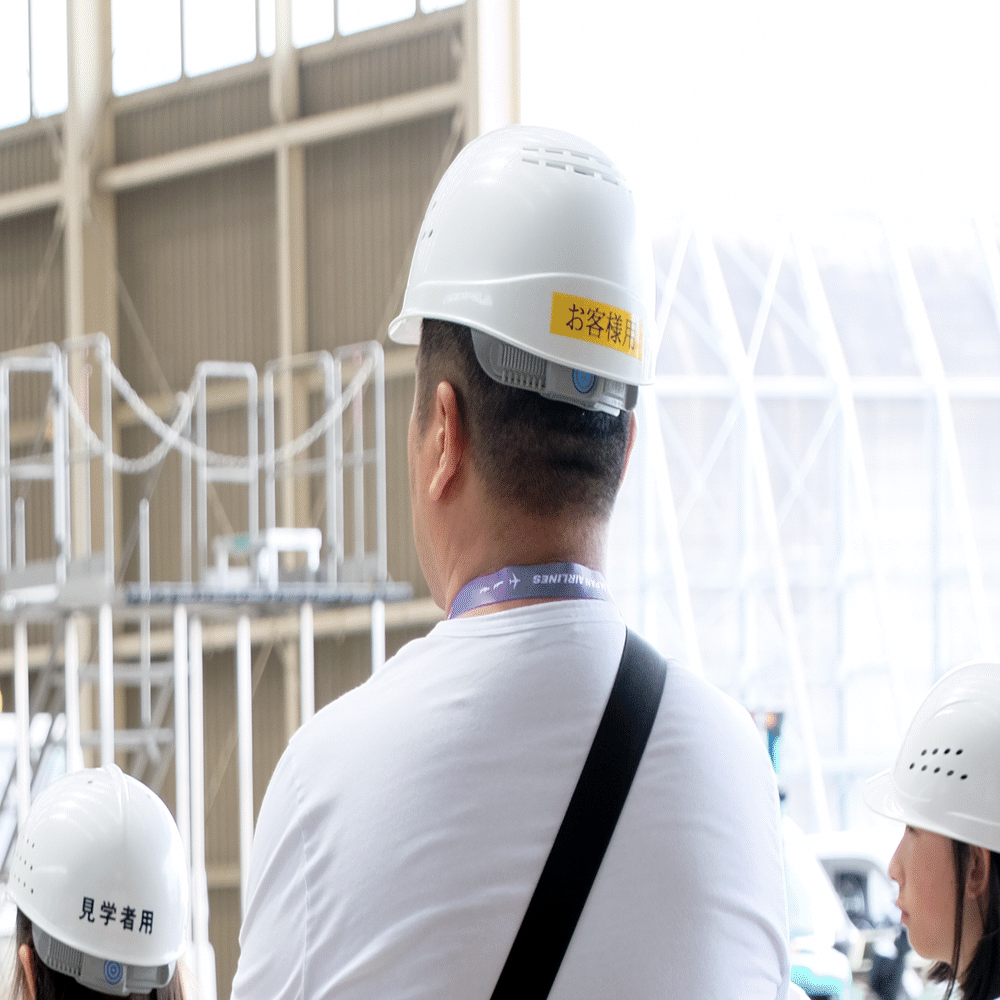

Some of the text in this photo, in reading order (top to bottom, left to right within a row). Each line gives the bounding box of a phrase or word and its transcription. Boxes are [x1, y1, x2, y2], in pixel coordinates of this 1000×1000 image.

[565, 303, 637, 350] お客様用
[532, 573, 584, 585] AIRLINES
[79, 896, 154, 935] 見学者用
